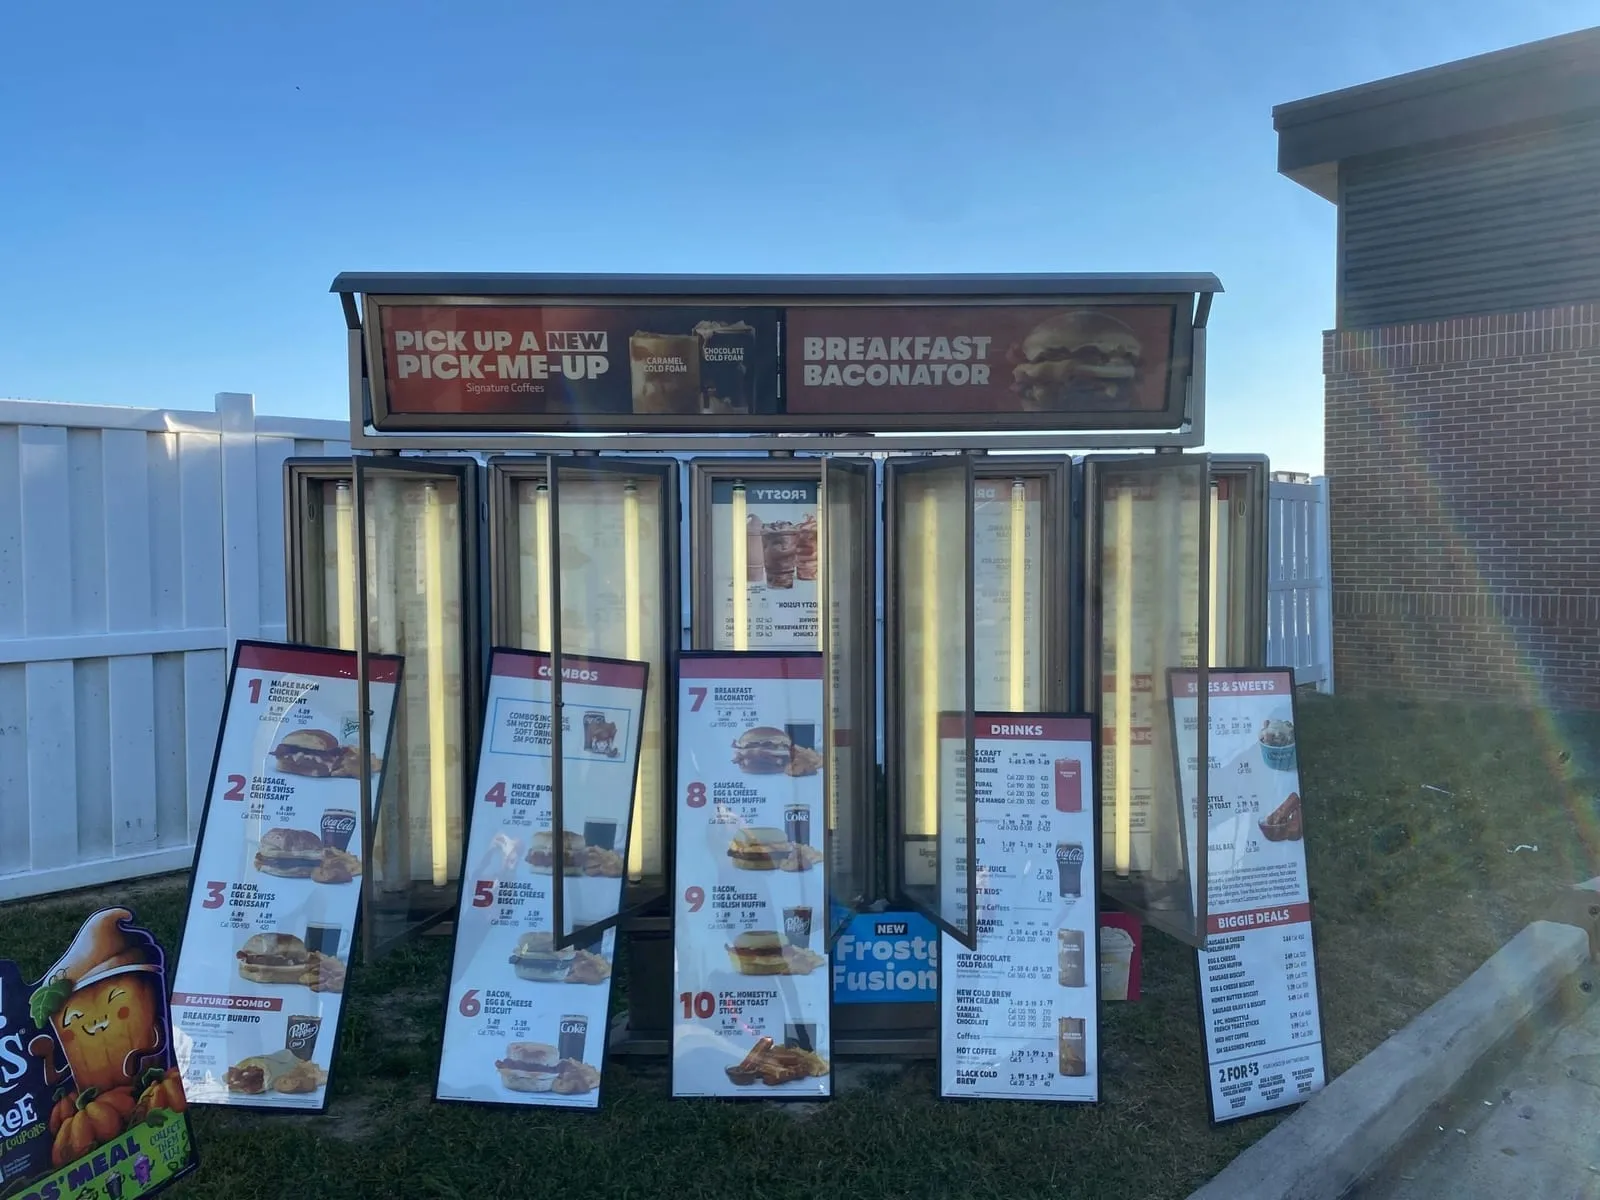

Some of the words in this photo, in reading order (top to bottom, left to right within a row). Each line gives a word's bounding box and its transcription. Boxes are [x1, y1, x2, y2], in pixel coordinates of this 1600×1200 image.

[395, 331, 469, 351] PICK
[474, 331, 512, 351] UP
[519, 331, 539, 351] A
[549, 333, 605, 350] NEW
[705, 347, 744, 355] CHOCOLATE
[804, 337, 991, 360] BREAKFAST
[647, 357, 683, 365] CARAMEL
[705, 354, 724, 362] COLD
[725, 354, 743, 362] FOAM
[399, 355, 609, 379] PICK-ME-UP
[644, 364, 664, 372] COLD
[665, 364, 687, 372] FOAM
[804, 364, 989, 385] BACONATOR
[467, 383, 509, 393] Signature
[511, 383, 544, 392] Coffees
[538, 667, 598, 681] CMBOS
[271, 680, 294, 688] MAPLE
[296, 682, 319, 691] BACON
[1223, 681, 1230, 691] &
[1232, 680, 1274, 691] SWEETS
[248, 679, 262, 703] 1
[270, 688, 299, 696] CHICKEN
[268, 696, 307, 704] CROISSANT
[688, 687, 707, 712] 7
[510, 712, 538, 721] COMBOS
[506, 720, 517, 728] SM
[514, 727, 532, 735] SOFT
[991, 725, 1043, 735] DRINKS
[223, 774, 247, 802] 2
[251, 784, 265, 792] EGG
[273, 786, 294, 794] SWISS
[512, 783, 534, 791] HONEY
[250, 792, 290, 801] CROISSANT
[484, 782, 506, 807] 4
[687, 782, 707, 808] 8
[510, 798, 537, 806] BISCUIT
[785, 812, 809, 822] Coke
[202, 881, 226, 909] 3
[472, 880, 494, 907] 5
[520, 891, 545, 899] CHEESE
[229, 900, 270, 908] CROISSANT
[498, 897, 525, 905] BISCUIT
[685, 886, 705, 913] 9
[1218, 916, 1254, 928] BIGGIE
[1257, 910, 1289, 923] DEALS
[878, 925, 905, 934] NEW
[973, 954, 1011, 962] CHOCOLATE
[185, 996, 234, 1005] FEATURED
[236, 999, 271, 1008] COMBO
[1227, 993, 1242, 1001] BUTTER
[459, 989, 480, 1017] 6
[485, 998, 499, 1006] EGG
[507, 999, 532, 1007] CHEESE
[680, 991, 715, 1019] 10
[484, 1007, 512, 1015] BISCUIT
[183, 1012, 226, 1021] BREAKFAST
[227, 1015, 260, 1023] BURRITO
[290, 1025, 317, 1037] Pepper
[561, 1022, 586, 1034] Coke
[1219, 1069, 1226, 1083] 2
[1228, 1065, 1248, 1081] FOR
[1249, 1062, 1259, 1076] $3
[68, 1136, 141, 1191] MEAL
